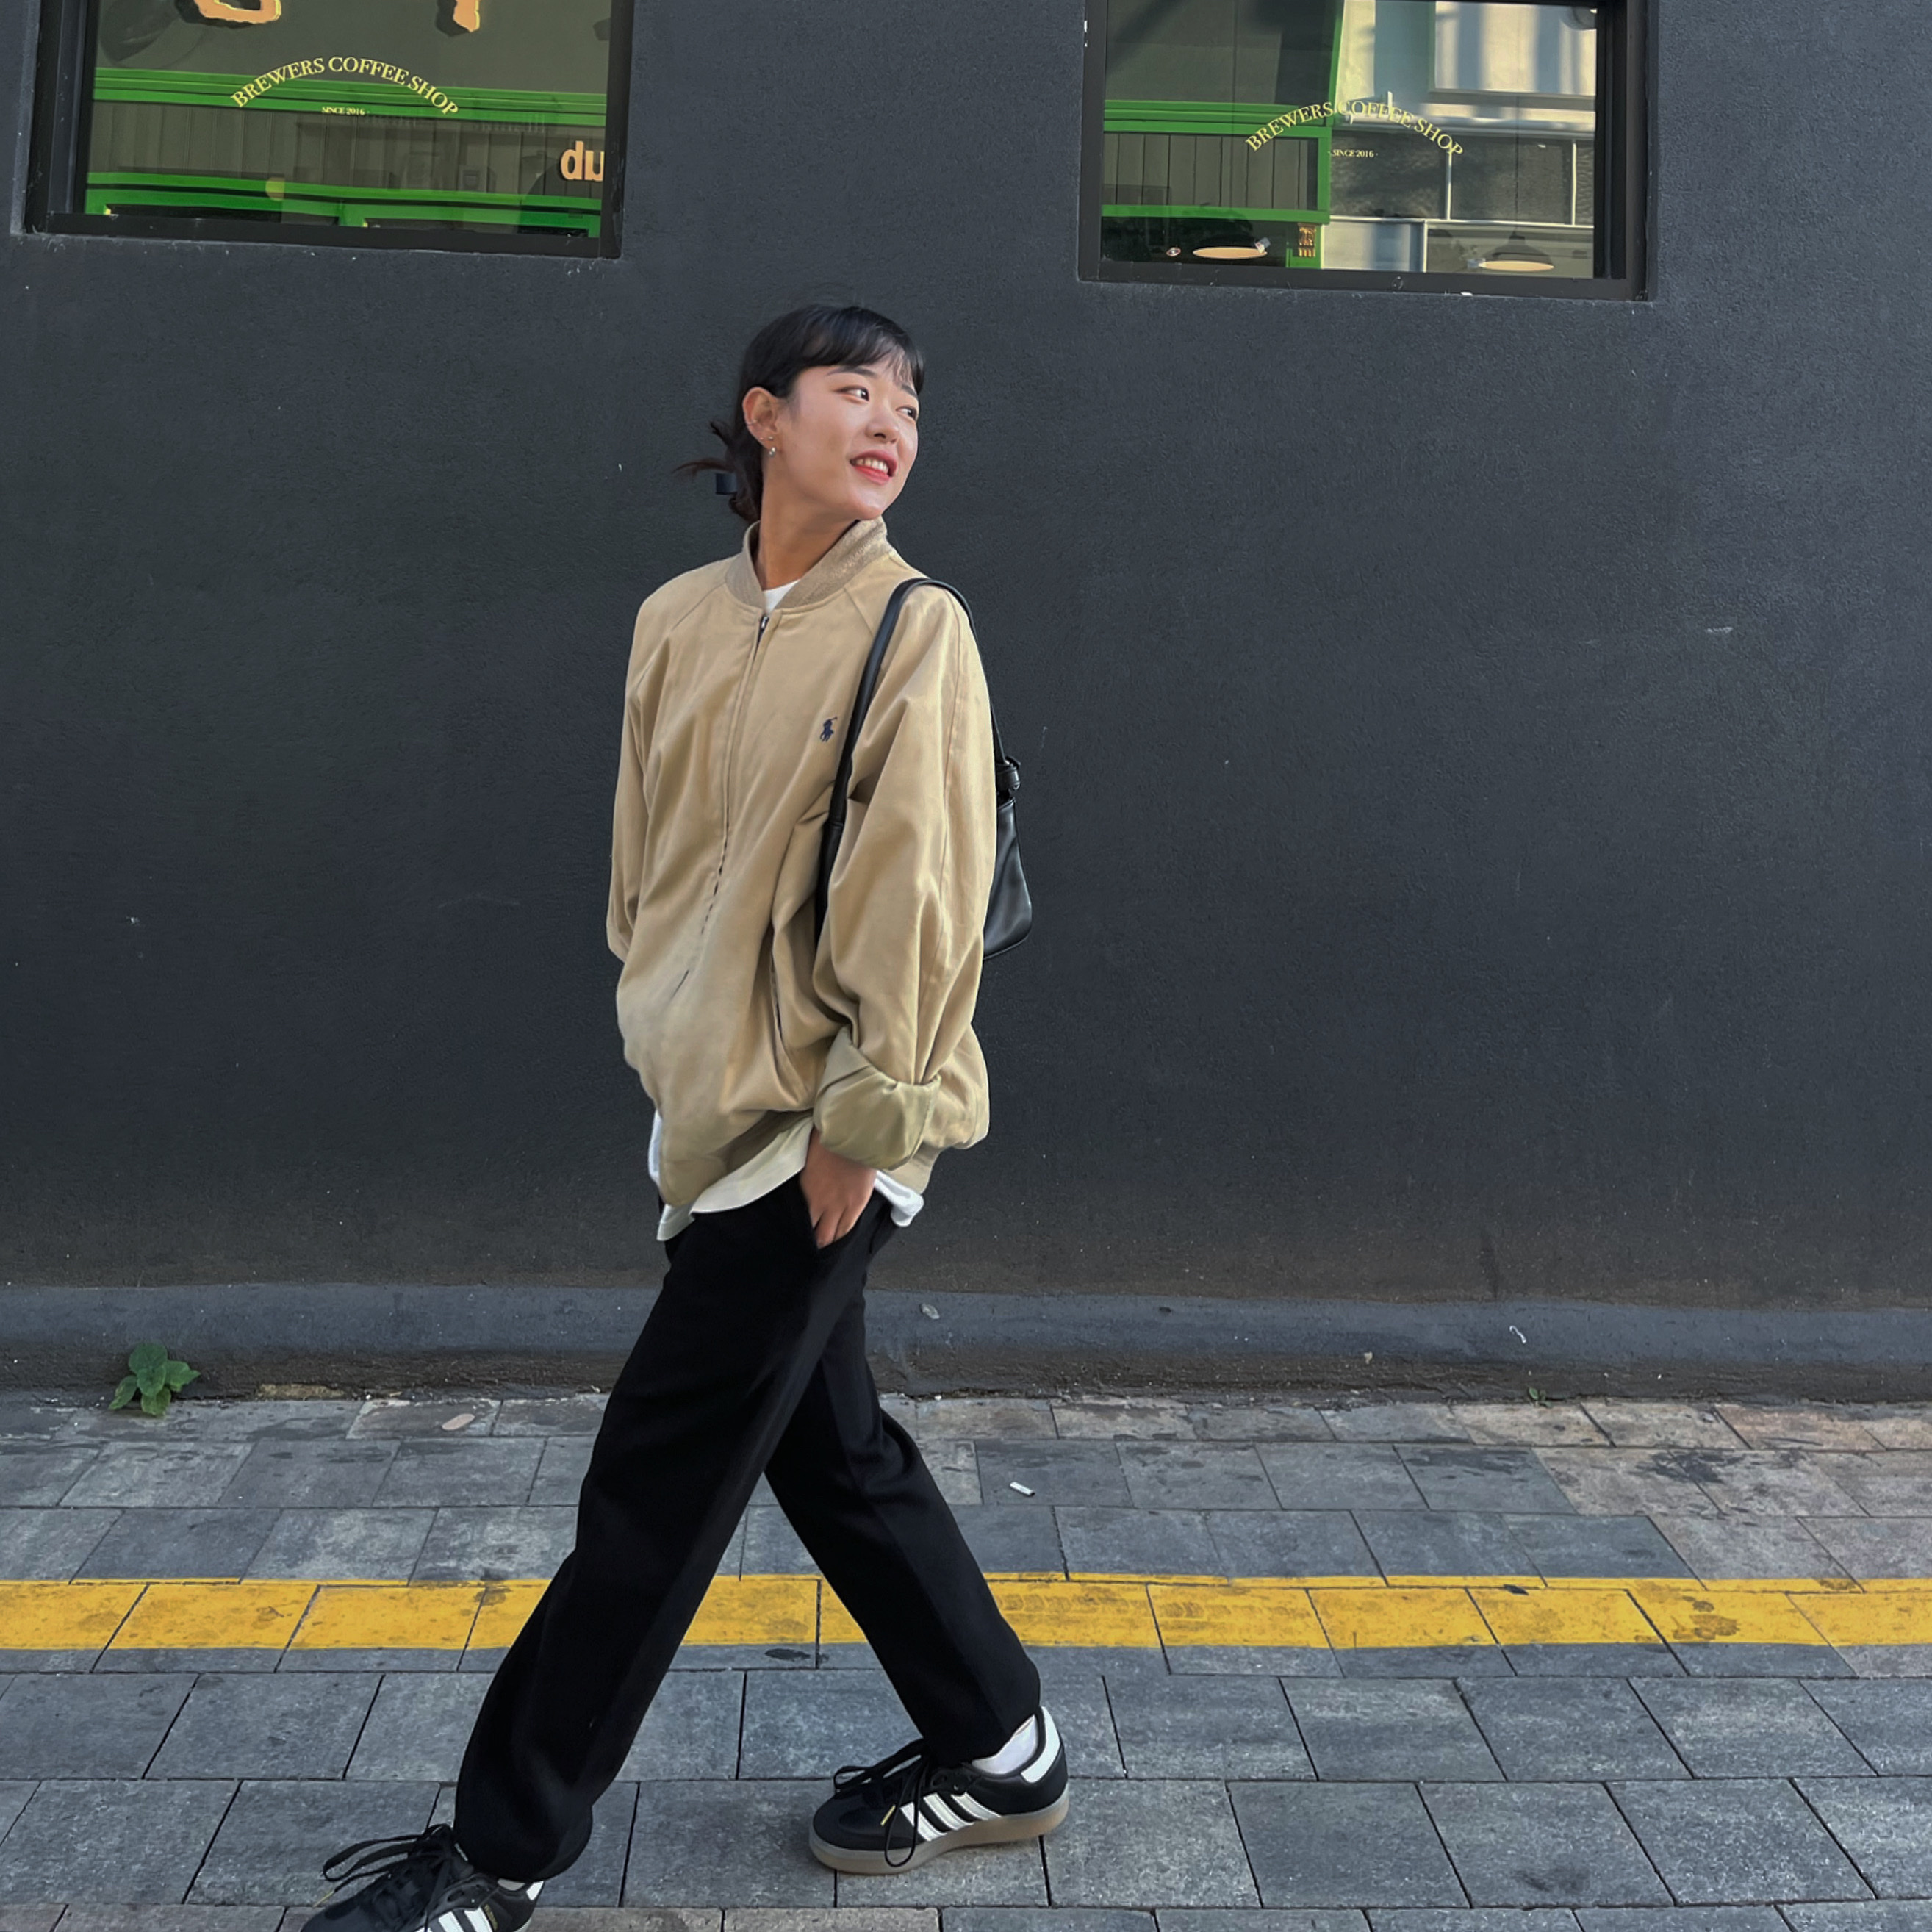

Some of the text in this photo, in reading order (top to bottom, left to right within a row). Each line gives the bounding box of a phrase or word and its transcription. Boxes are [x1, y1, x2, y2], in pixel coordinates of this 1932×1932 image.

[231, 57, 459, 115] BREWERS COFFEE SHOP
[346, 107, 365, 115] 2016
[1245, 101, 1463, 155] BREWERS COFFEE SHOP
